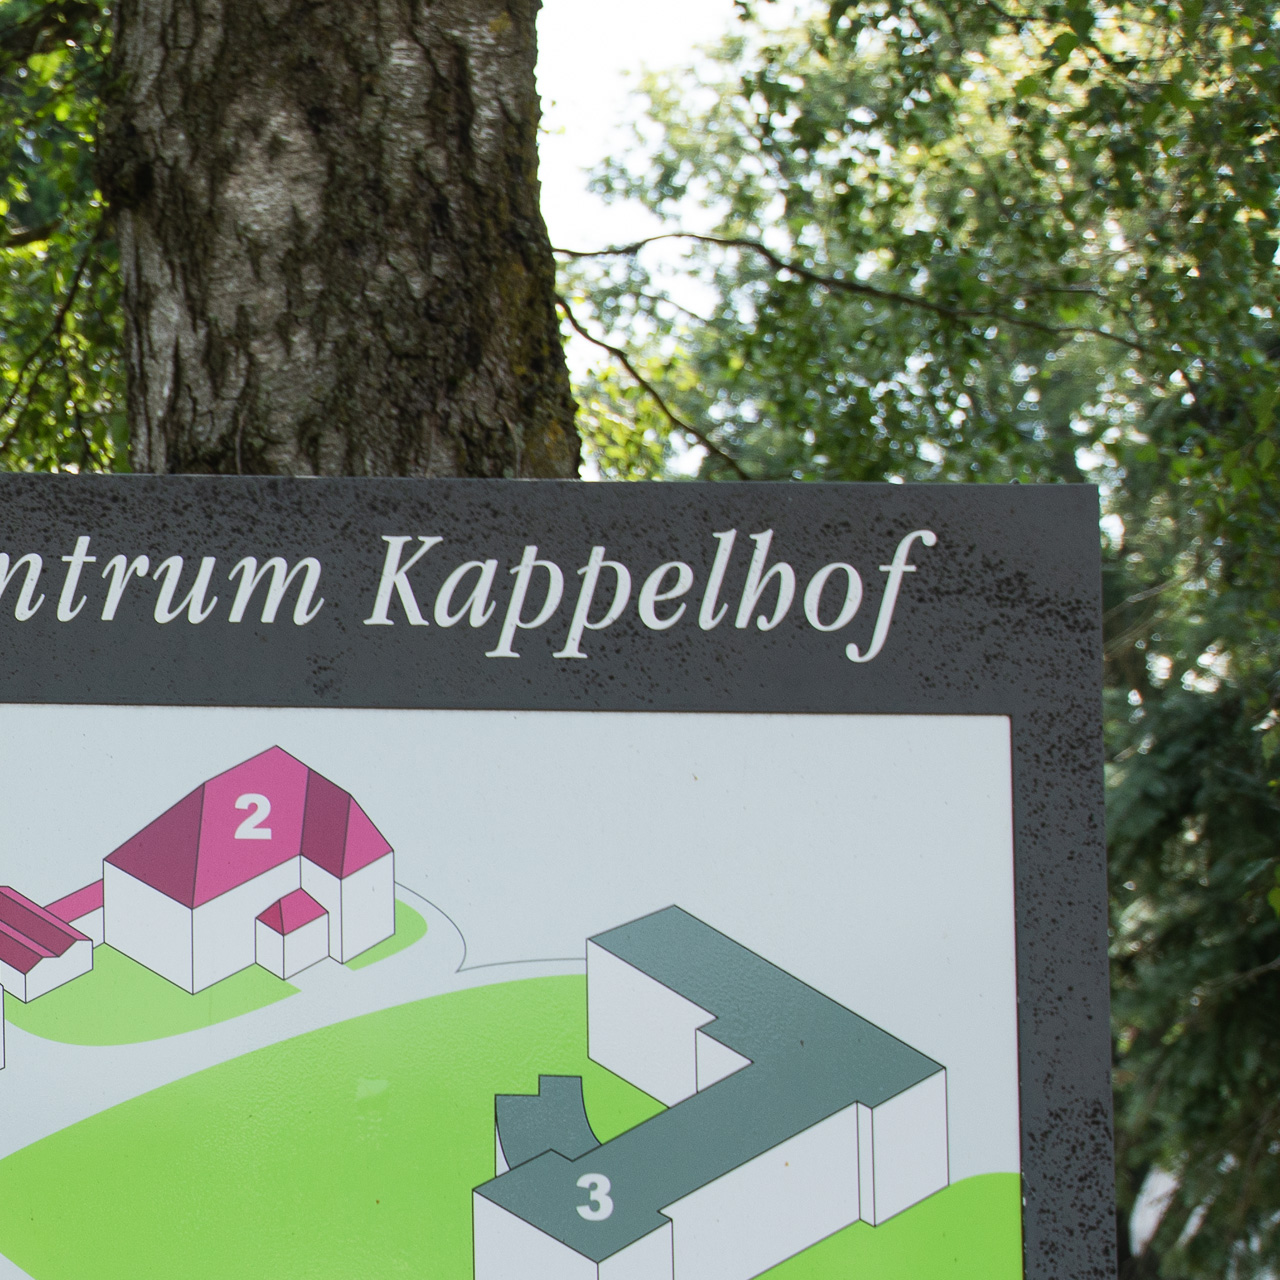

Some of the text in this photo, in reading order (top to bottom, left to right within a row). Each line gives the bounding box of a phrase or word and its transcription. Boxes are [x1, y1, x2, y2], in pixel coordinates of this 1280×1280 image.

[361, 527, 938, 664] Kappelhof
[233, 791, 274, 842] 2
[574, 1171, 616, 1223] 3
